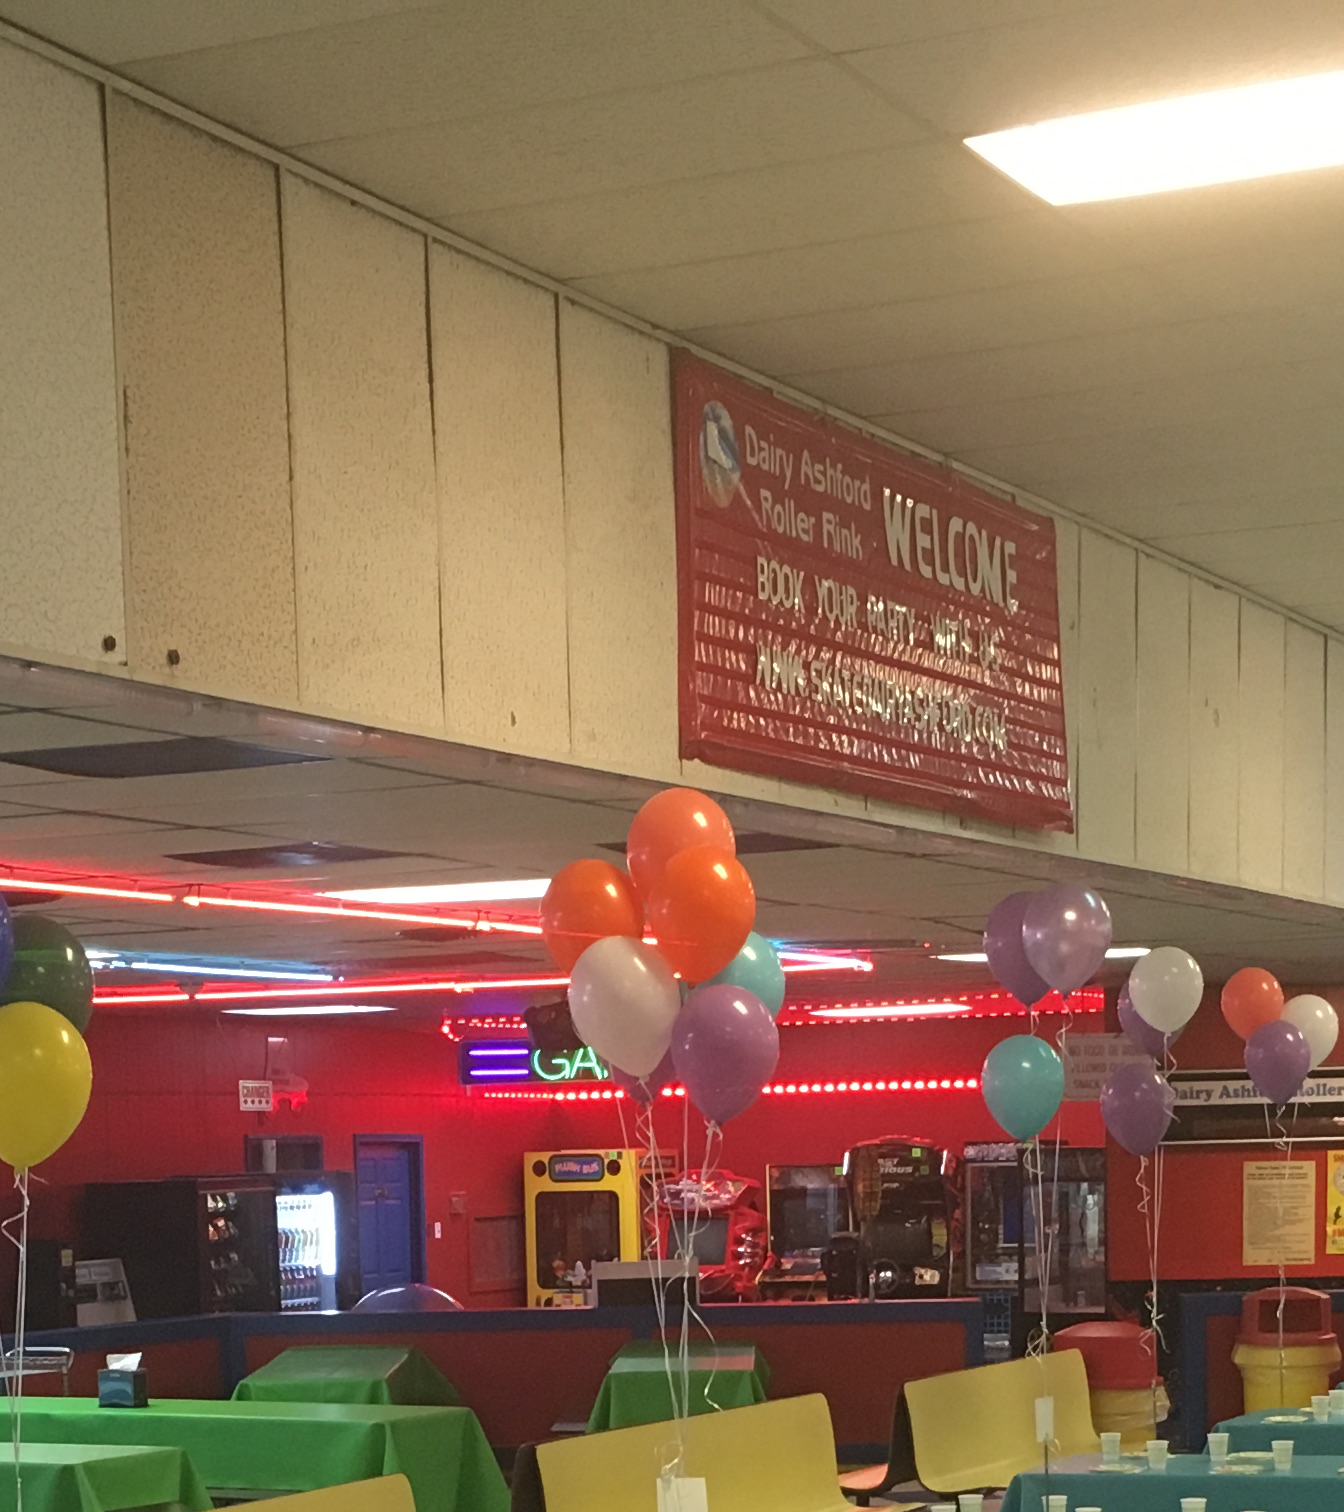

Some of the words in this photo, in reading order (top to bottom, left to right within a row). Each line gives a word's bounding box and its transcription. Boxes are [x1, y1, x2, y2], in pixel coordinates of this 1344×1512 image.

[745, 425, 793, 490] Dairy
[801, 449, 872, 511] Ashford
[760, 488, 816, 543] Roller
[822, 511, 863, 560] Rink
[882, 487, 1019, 615] WELCOME
[756, 555, 805, 614] BOOK
[814, 575, 857, 629] YOUR
[867, 595, 916, 643] PARTY
